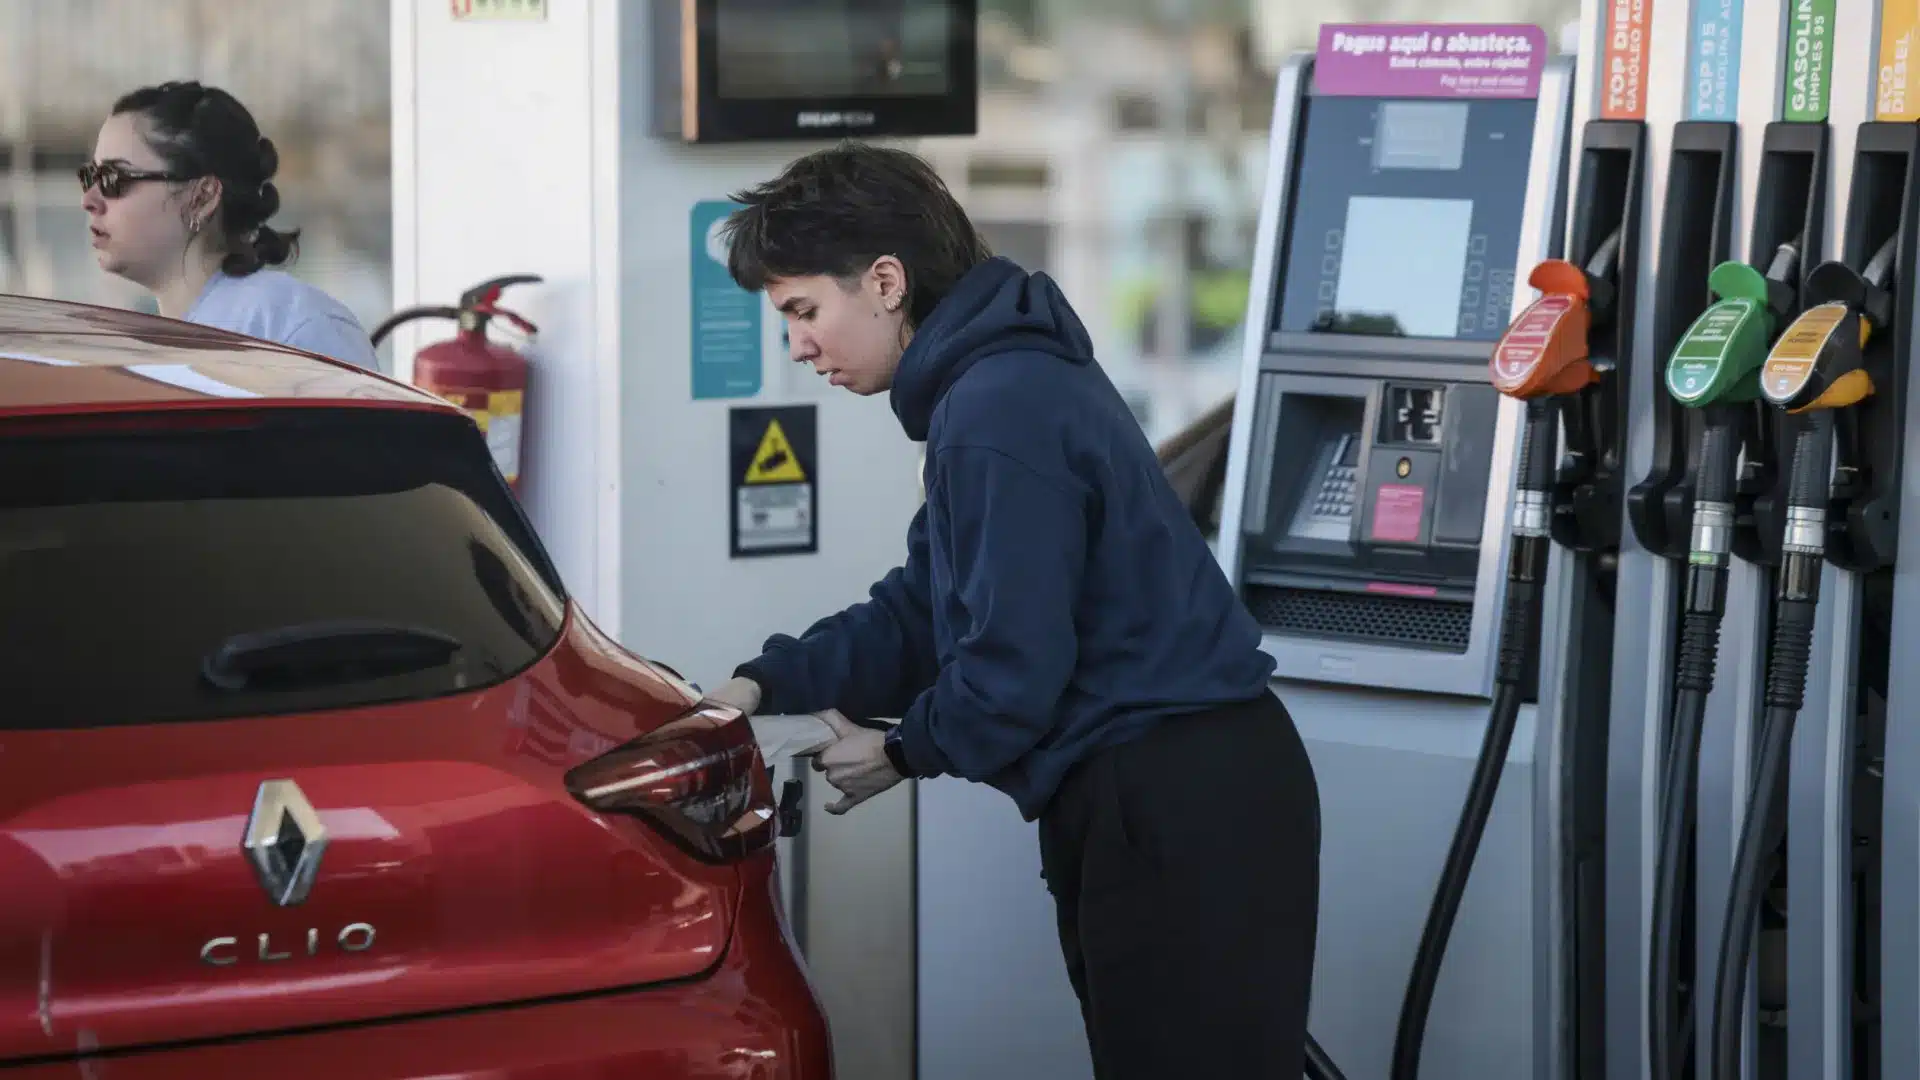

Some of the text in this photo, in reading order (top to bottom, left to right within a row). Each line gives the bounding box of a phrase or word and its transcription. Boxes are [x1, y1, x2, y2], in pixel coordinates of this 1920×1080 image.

[1333, 31, 1532, 55] Pague aqui e abasteça.
[1791, 0, 1812, 112] GASOLIN
[1808, 15, 1825, 112] SIMPLES 95
[1609, 56, 1625, 112] TOP
[1698, 62, 1713, 114] TOP
[1891, 31, 1910, 113] DIESEL
[201, 922, 376, 965] CLIO
